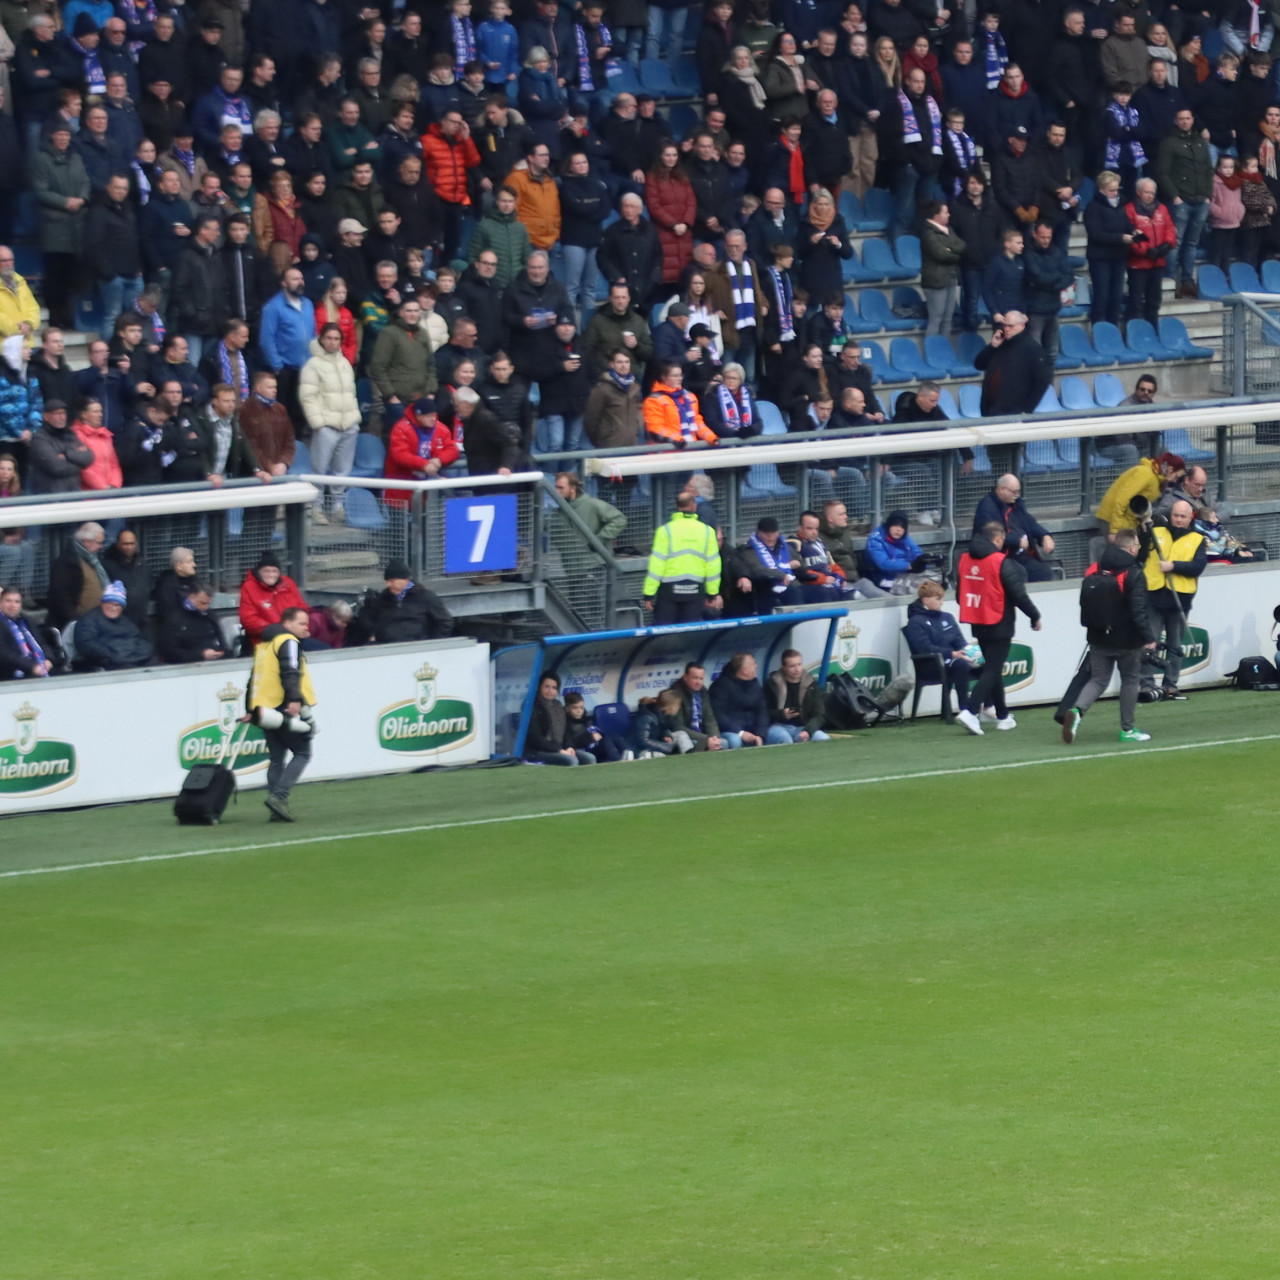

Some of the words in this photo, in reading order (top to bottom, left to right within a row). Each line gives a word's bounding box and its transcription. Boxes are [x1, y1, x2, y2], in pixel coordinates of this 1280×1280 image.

[467, 505, 496, 563] 7
[966, 593, 982, 608] TV
[382, 714, 468, 740] Oliehoorn
